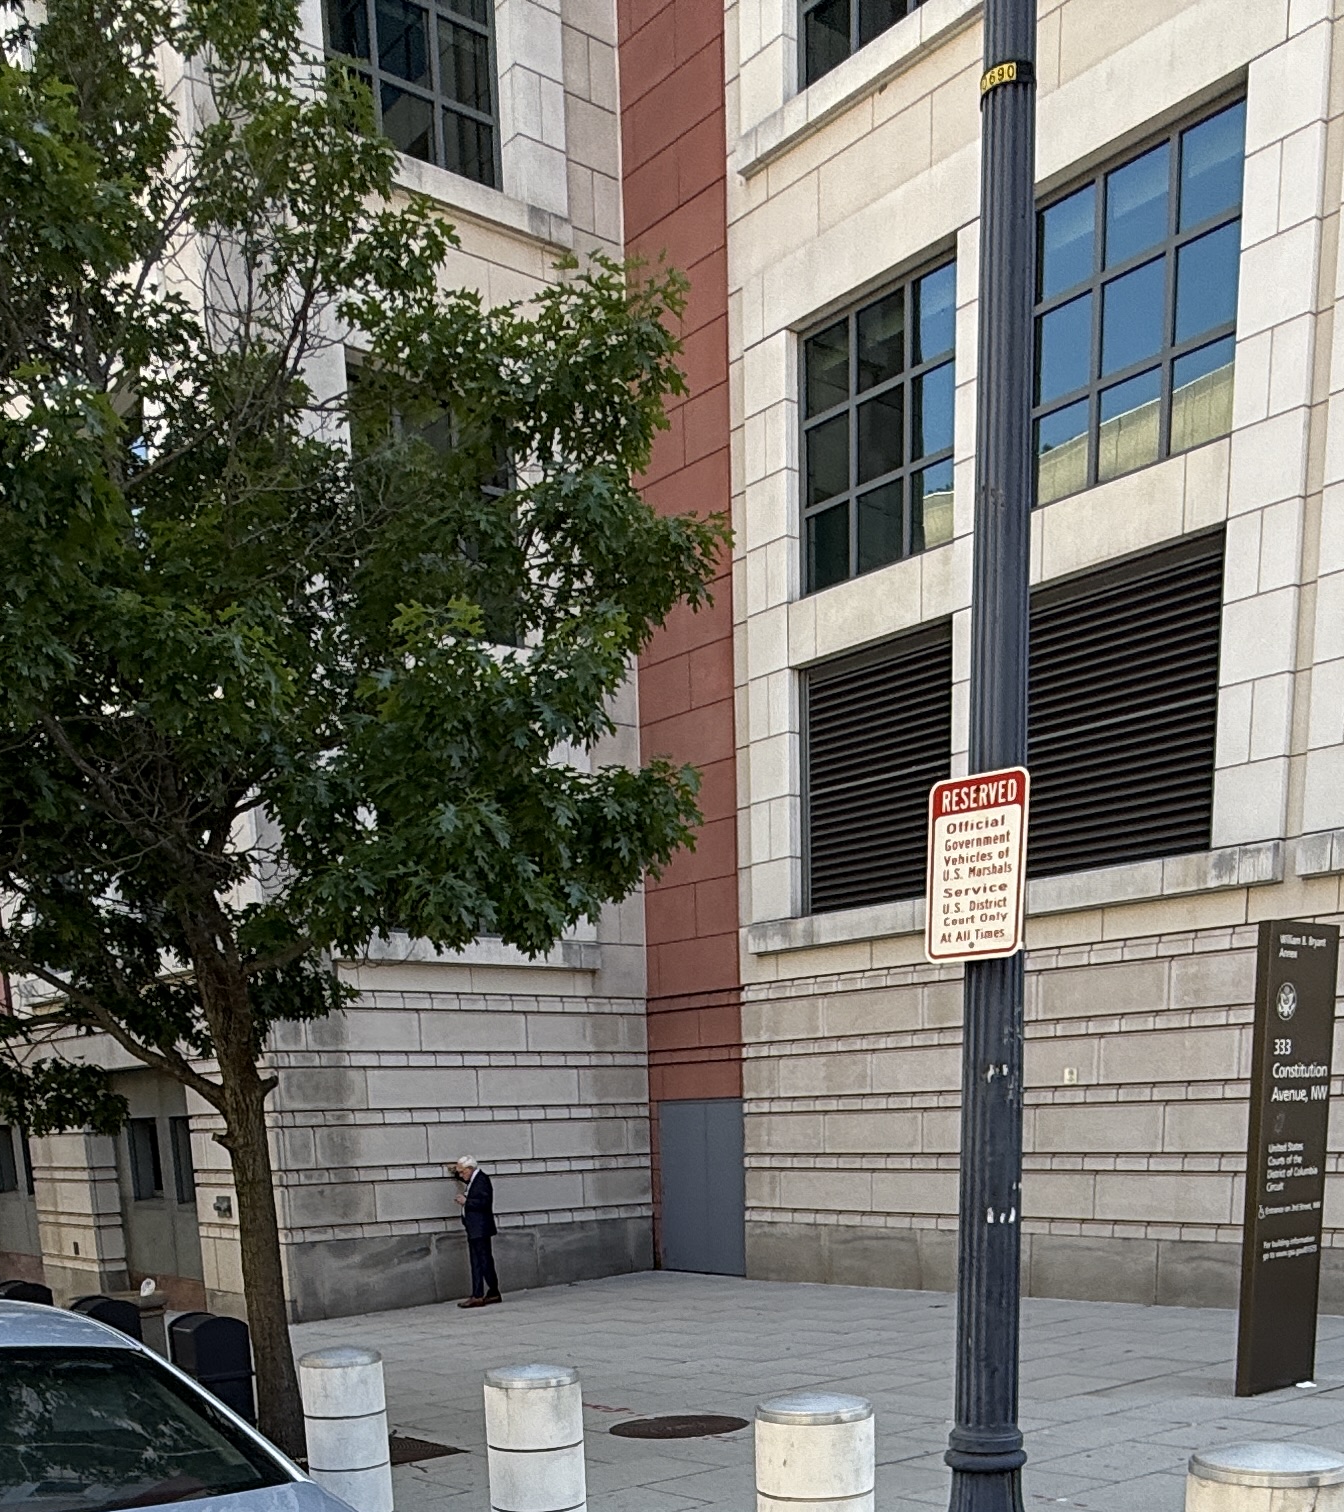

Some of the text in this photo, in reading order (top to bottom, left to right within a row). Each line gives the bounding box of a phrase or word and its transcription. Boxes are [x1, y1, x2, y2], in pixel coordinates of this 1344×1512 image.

[941, 778, 1018, 813] RESERVED
[946, 814, 1005, 835] Official
[944, 829, 1011, 852] Government
[943, 846, 1010, 867] Vehicles of
[942, 861, 1012, 882] U.S. Marshals
[942, 883, 1008, 899] Service
[942, 896, 1007, 915] U.S. District
[943, 911, 1009, 926] Court Only
[940, 928, 1005, 943] At All Times
[1273, 1038, 1292, 1056] 333
[1272, 1061, 1328, 1079] Constitution
[1271, 1084, 1329, 1103] Avenue, NW
